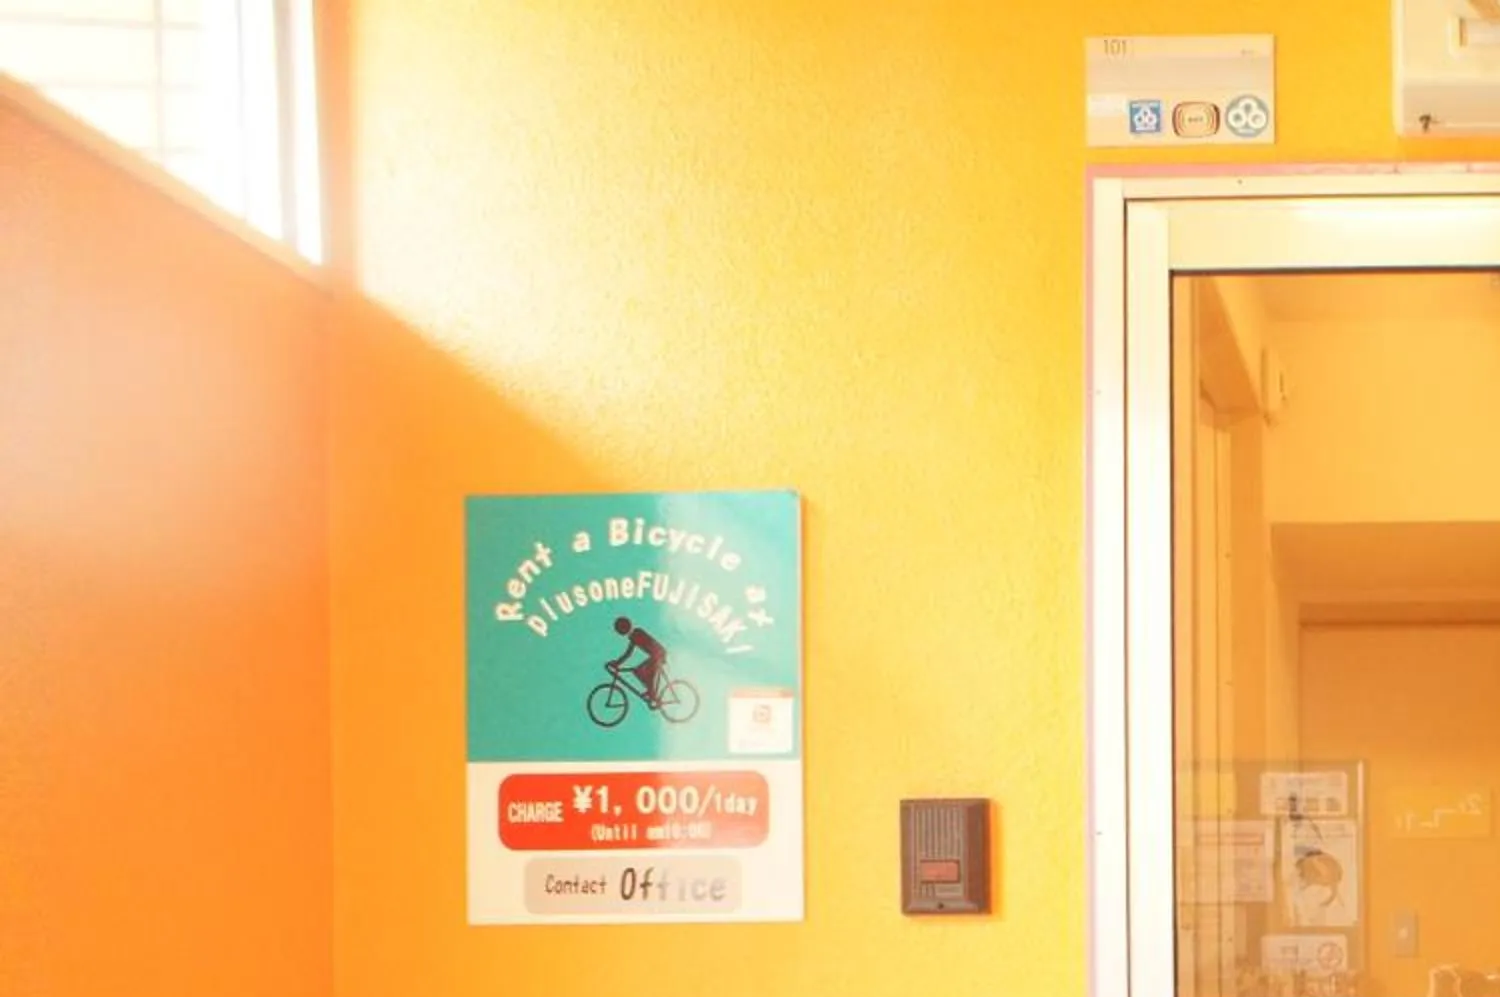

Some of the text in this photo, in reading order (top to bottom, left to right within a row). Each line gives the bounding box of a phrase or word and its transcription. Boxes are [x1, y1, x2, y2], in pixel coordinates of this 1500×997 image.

[1103, 39, 1127, 56] 101
[496, 517, 774, 627] Rent a Bicycle at
[507, 800, 565, 823] CHARGE
[544, 867, 728, 901] Contact Office
